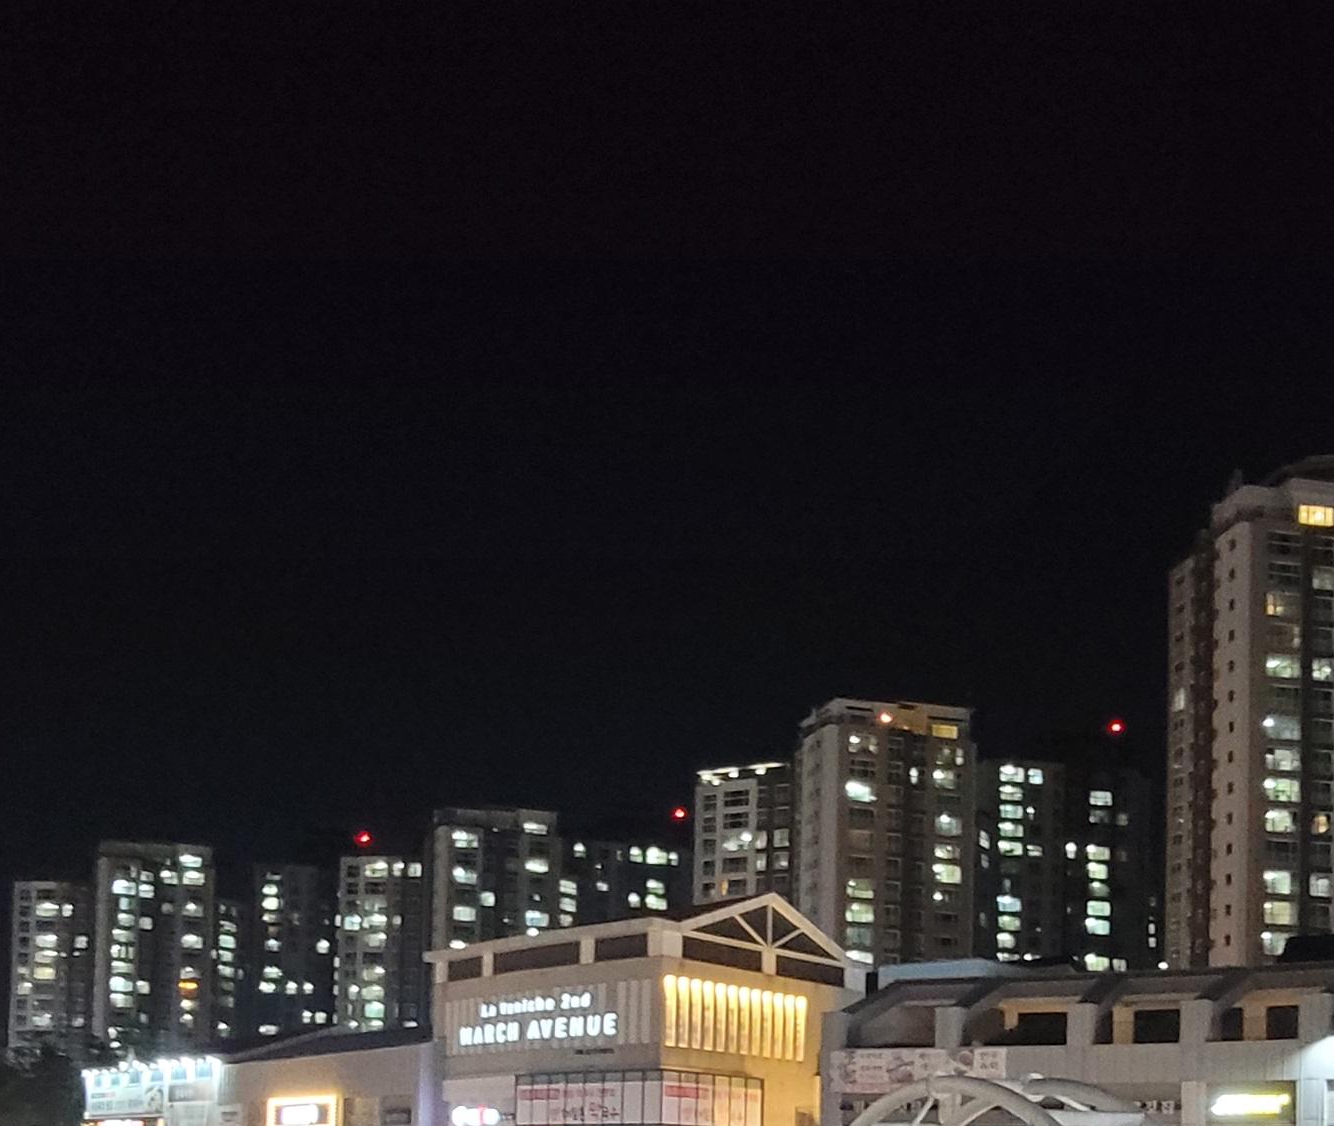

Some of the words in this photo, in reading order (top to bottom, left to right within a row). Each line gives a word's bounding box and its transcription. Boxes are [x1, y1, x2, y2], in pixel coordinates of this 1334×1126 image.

[480, 1002, 498, 1018] La
[560, 991, 592, 1010] 2nd
[459, 1020, 521, 1046] MARCH
[526, 1012, 618, 1040] AVENUE
